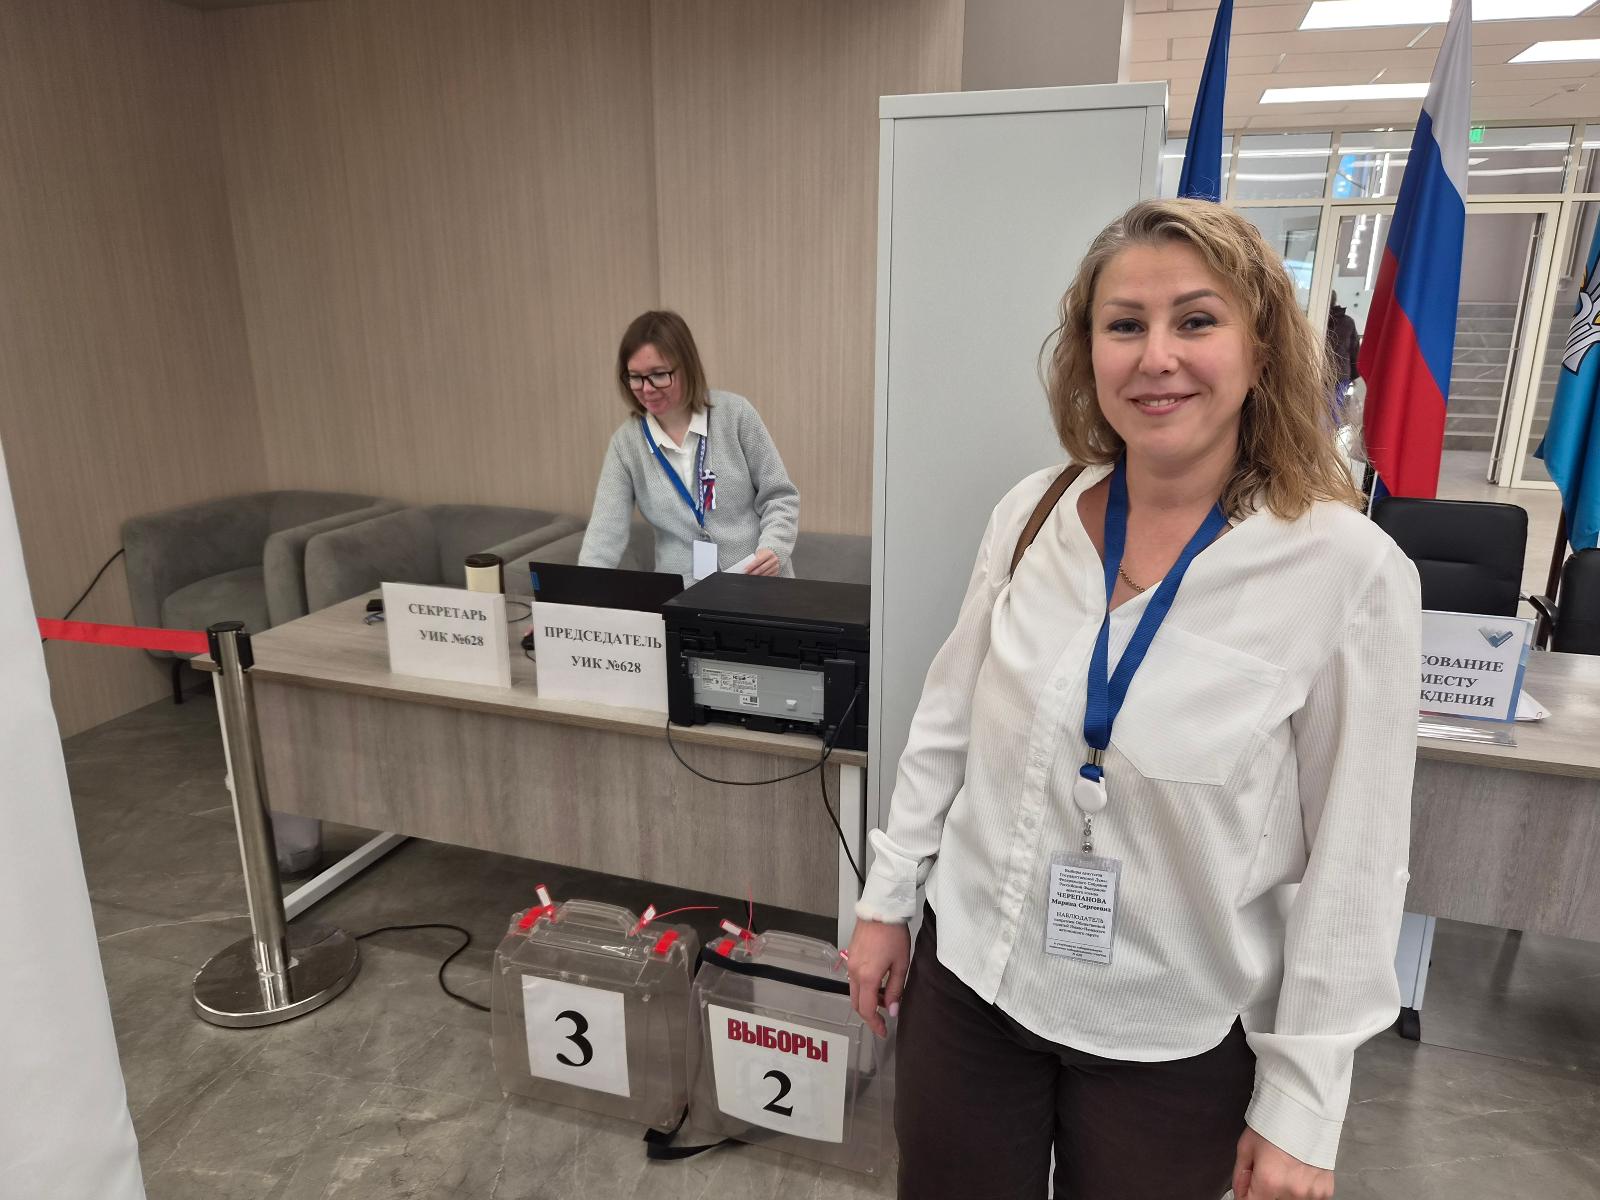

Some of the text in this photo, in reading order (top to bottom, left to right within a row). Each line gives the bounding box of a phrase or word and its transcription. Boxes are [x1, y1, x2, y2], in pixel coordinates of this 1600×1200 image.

[408, 603, 487, 621] СЕКРЕТАРЬ
[419, 629, 484, 647] УИК №628
[544, 625, 663, 649] ПРЕДСЕДАТЕЛЬ
[571, 655, 642, 674] УИК №628
[1421, 673, 1479, 688] МЕСТУ
[1051, 898, 1077, 907] Марина
[1057, 892, 1106, 904] ЧЕРЕПАНОВА
[1056, 911, 1104, 923] НАБЛЮДАТЕЛЬ
[554, 1010, 594, 1067] 3
[727, 1017, 829, 1063] ВЫБОРЫ
[762, 1070, 794, 1117] 2
